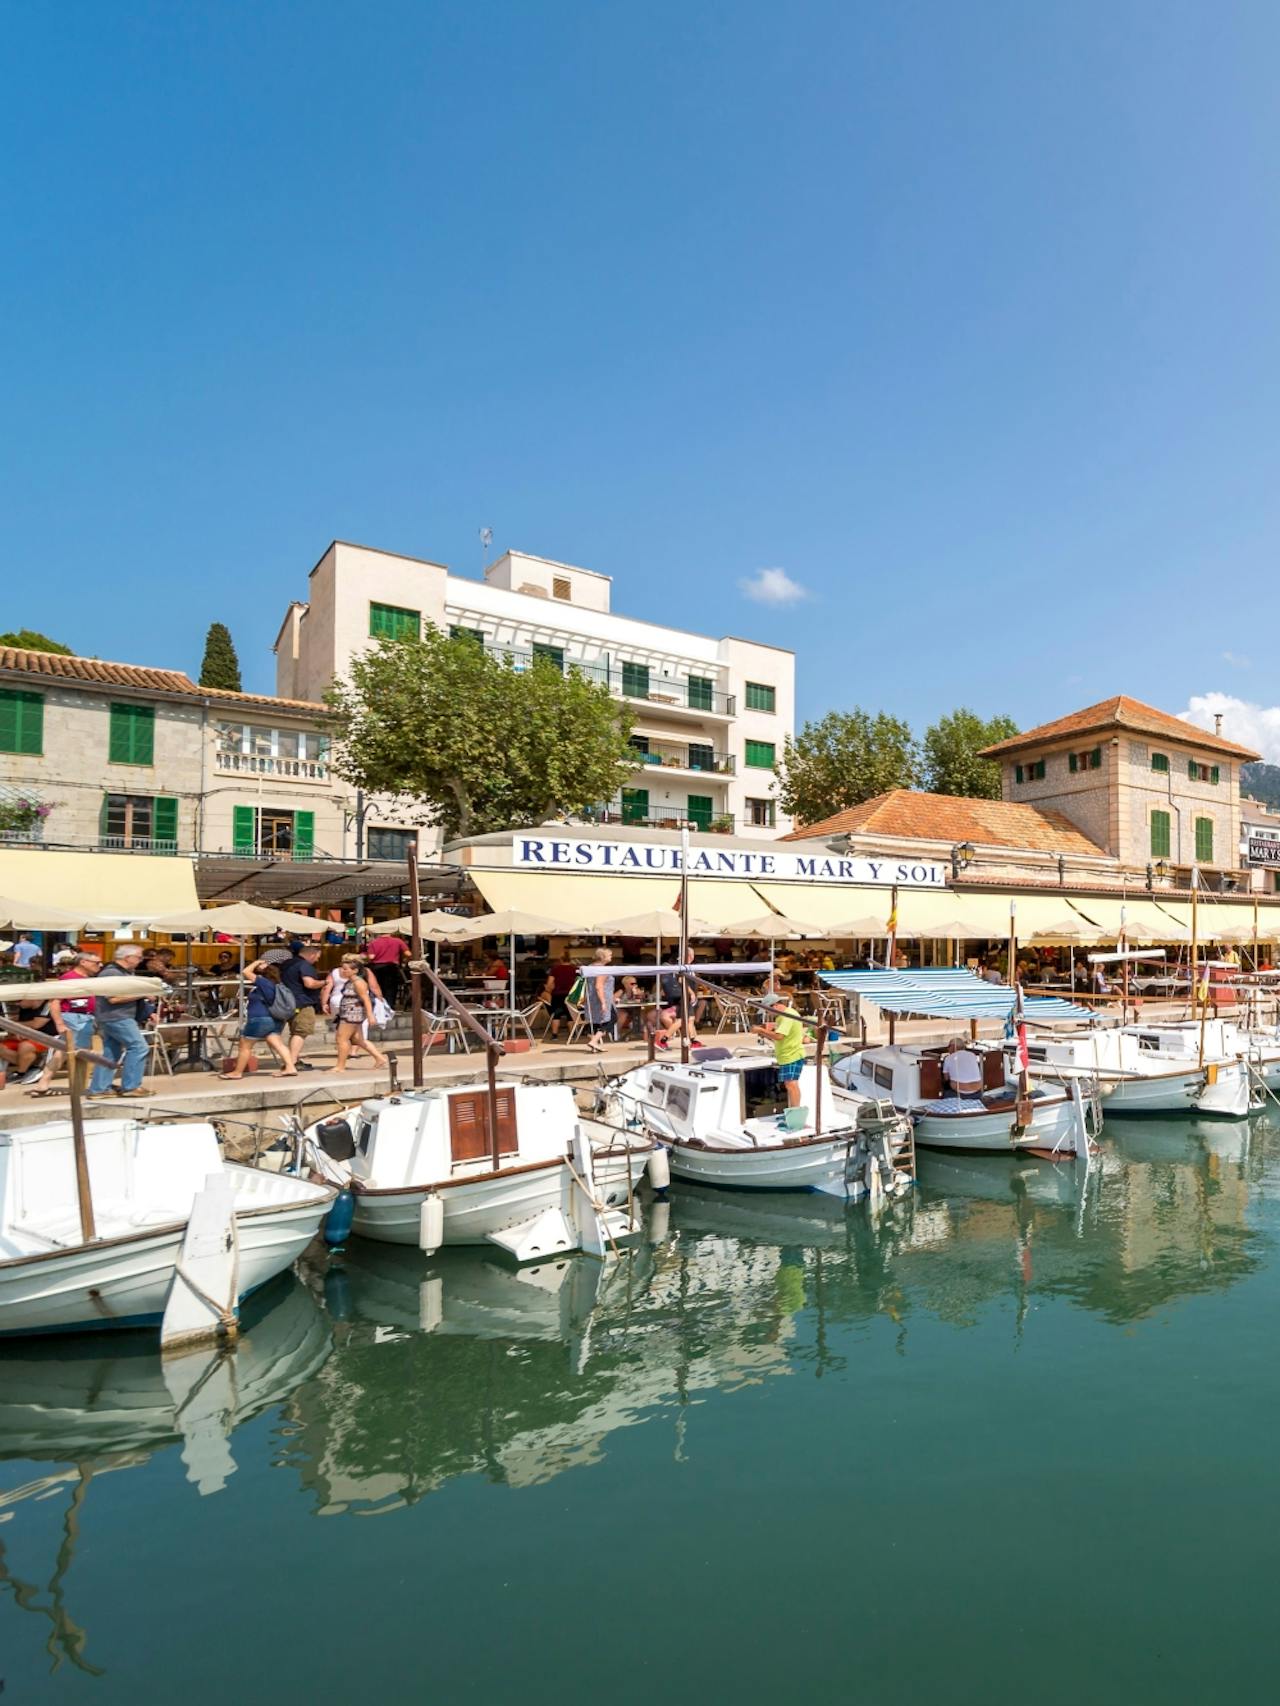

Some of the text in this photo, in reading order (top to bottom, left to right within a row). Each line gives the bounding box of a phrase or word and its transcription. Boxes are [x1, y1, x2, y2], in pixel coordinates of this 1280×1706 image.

[520, 840, 941, 883] RESTAURANTE MAR Y SOL
[1250, 846, 1270, 859] MAR
[1270, 848, 1276, 860] Y
